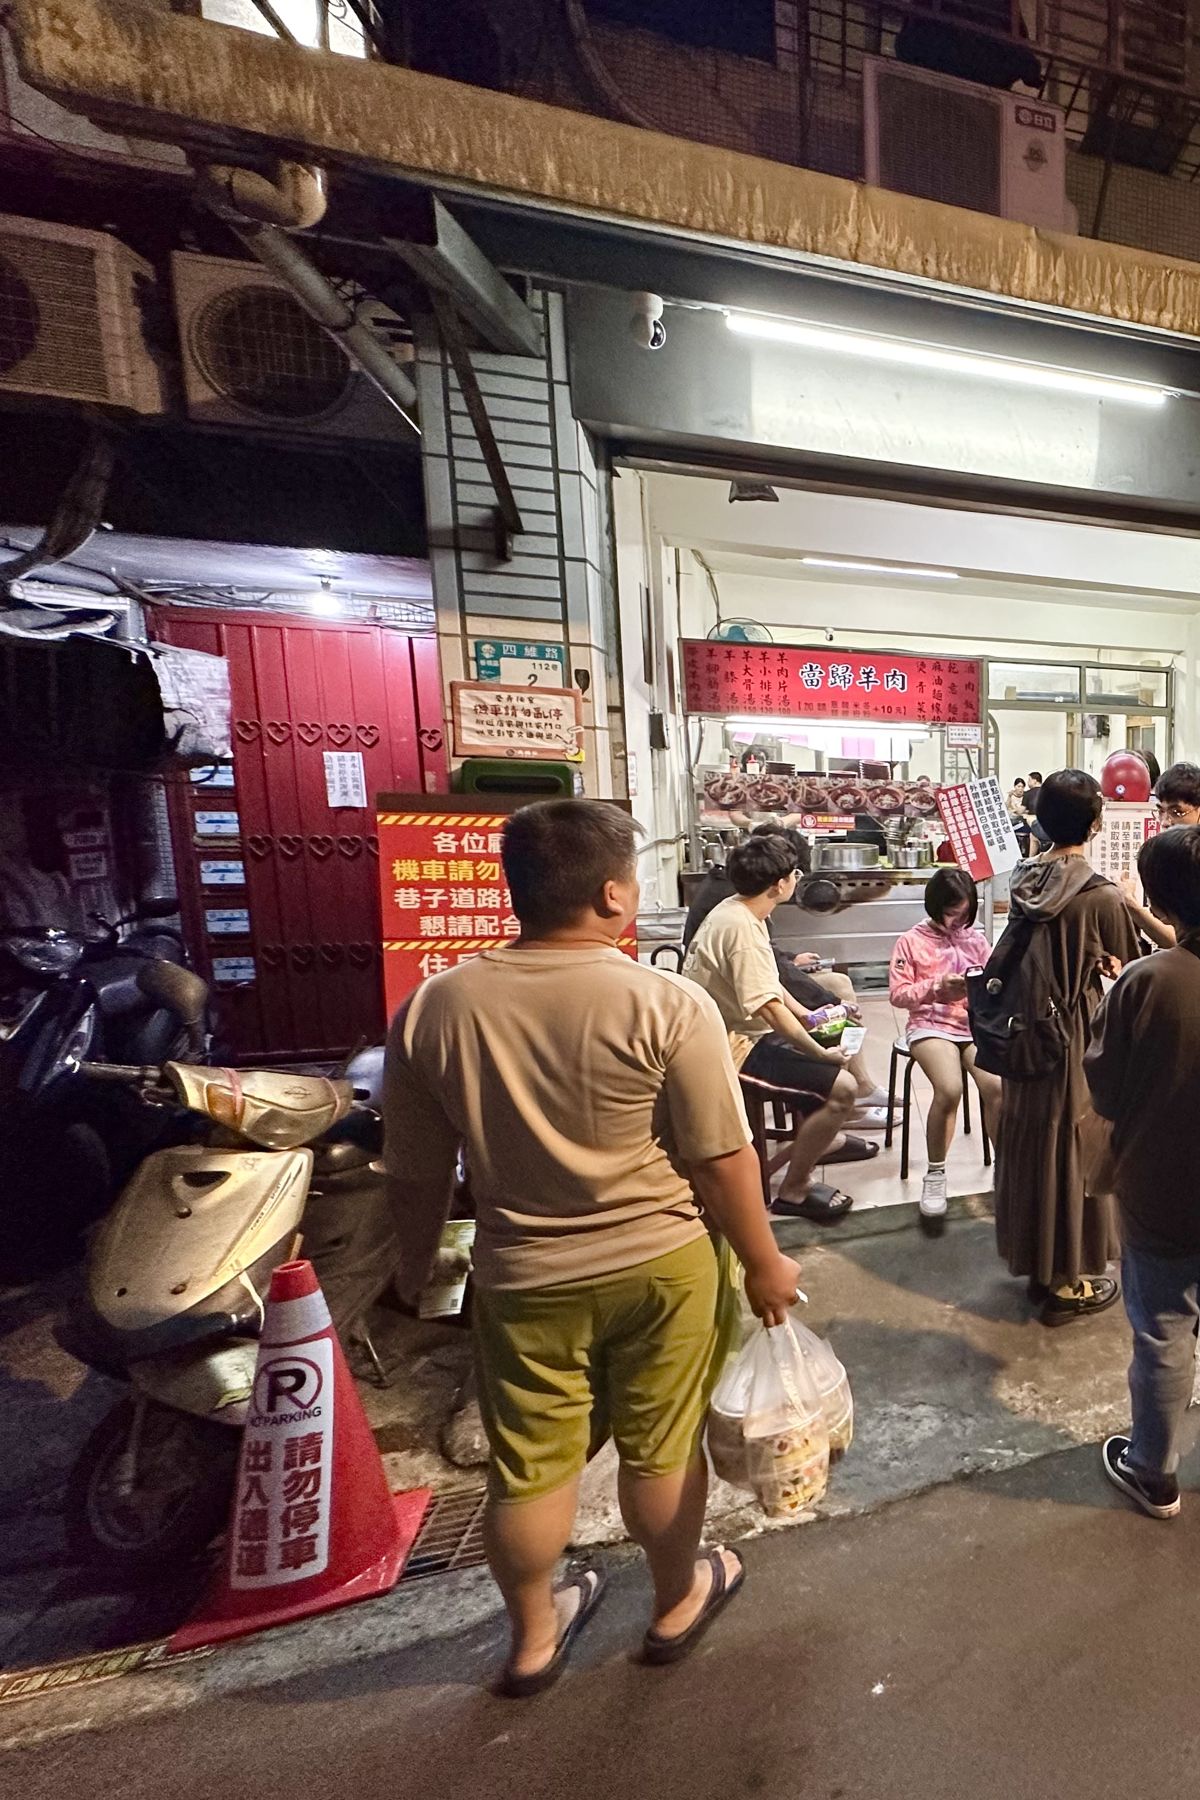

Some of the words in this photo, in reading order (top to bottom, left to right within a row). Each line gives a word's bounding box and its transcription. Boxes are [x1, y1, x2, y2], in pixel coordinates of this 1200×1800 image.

[502, 644, 559, 659] 四維路
[742, 650, 756, 705] 羊大骨湯
[759, 651, 773, 706] 羊小排湯
[776, 652, 790, 707] 羊肉片湯
[799, 663, 908, 692] 當歸羊肉
[420, 914, 522, 937] 懇請配合
[263, 1406, 322, 1427] PARKING
[278, 1431, 323, 1571] 請勿停車
